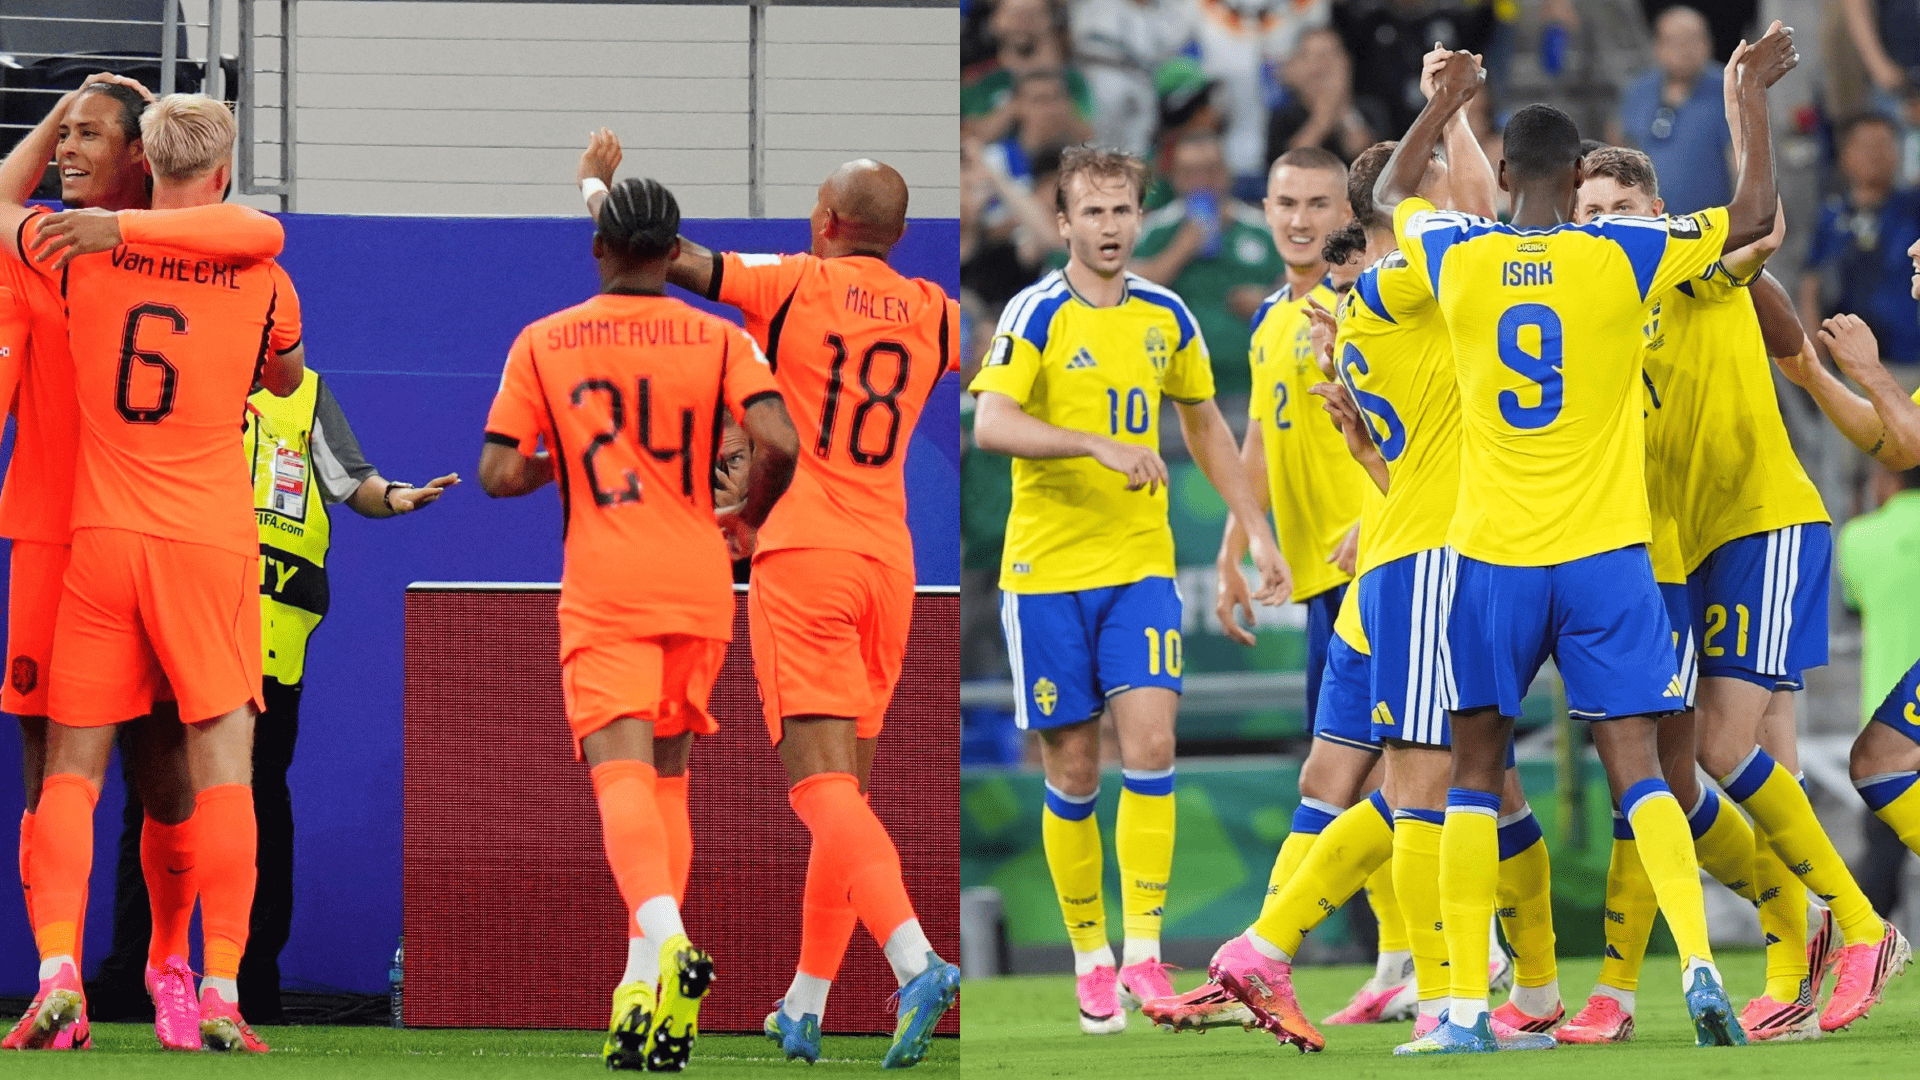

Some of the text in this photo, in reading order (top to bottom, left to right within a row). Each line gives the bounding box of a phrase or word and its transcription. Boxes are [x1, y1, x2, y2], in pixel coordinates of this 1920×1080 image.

[111, 243, 243, 290] Van HECKE
[1502, 260, 1553, 287] ISAK
[845, 284, 910, 324] MALEN
[547, 318, 713, 351] SUMMERVILLE
[114, 301, 189, 426] 6
[1497, 302, 1564, 430] 9
[814, 331, 913, 469] 18
[1106, 387, 1149, 436] 10
[1274, 381, 1292, 430] 2
[569, 375, 698, 508] 24
[1143, 626, 1183, 678] 10
[1703, 603, 1750, 657] 21
